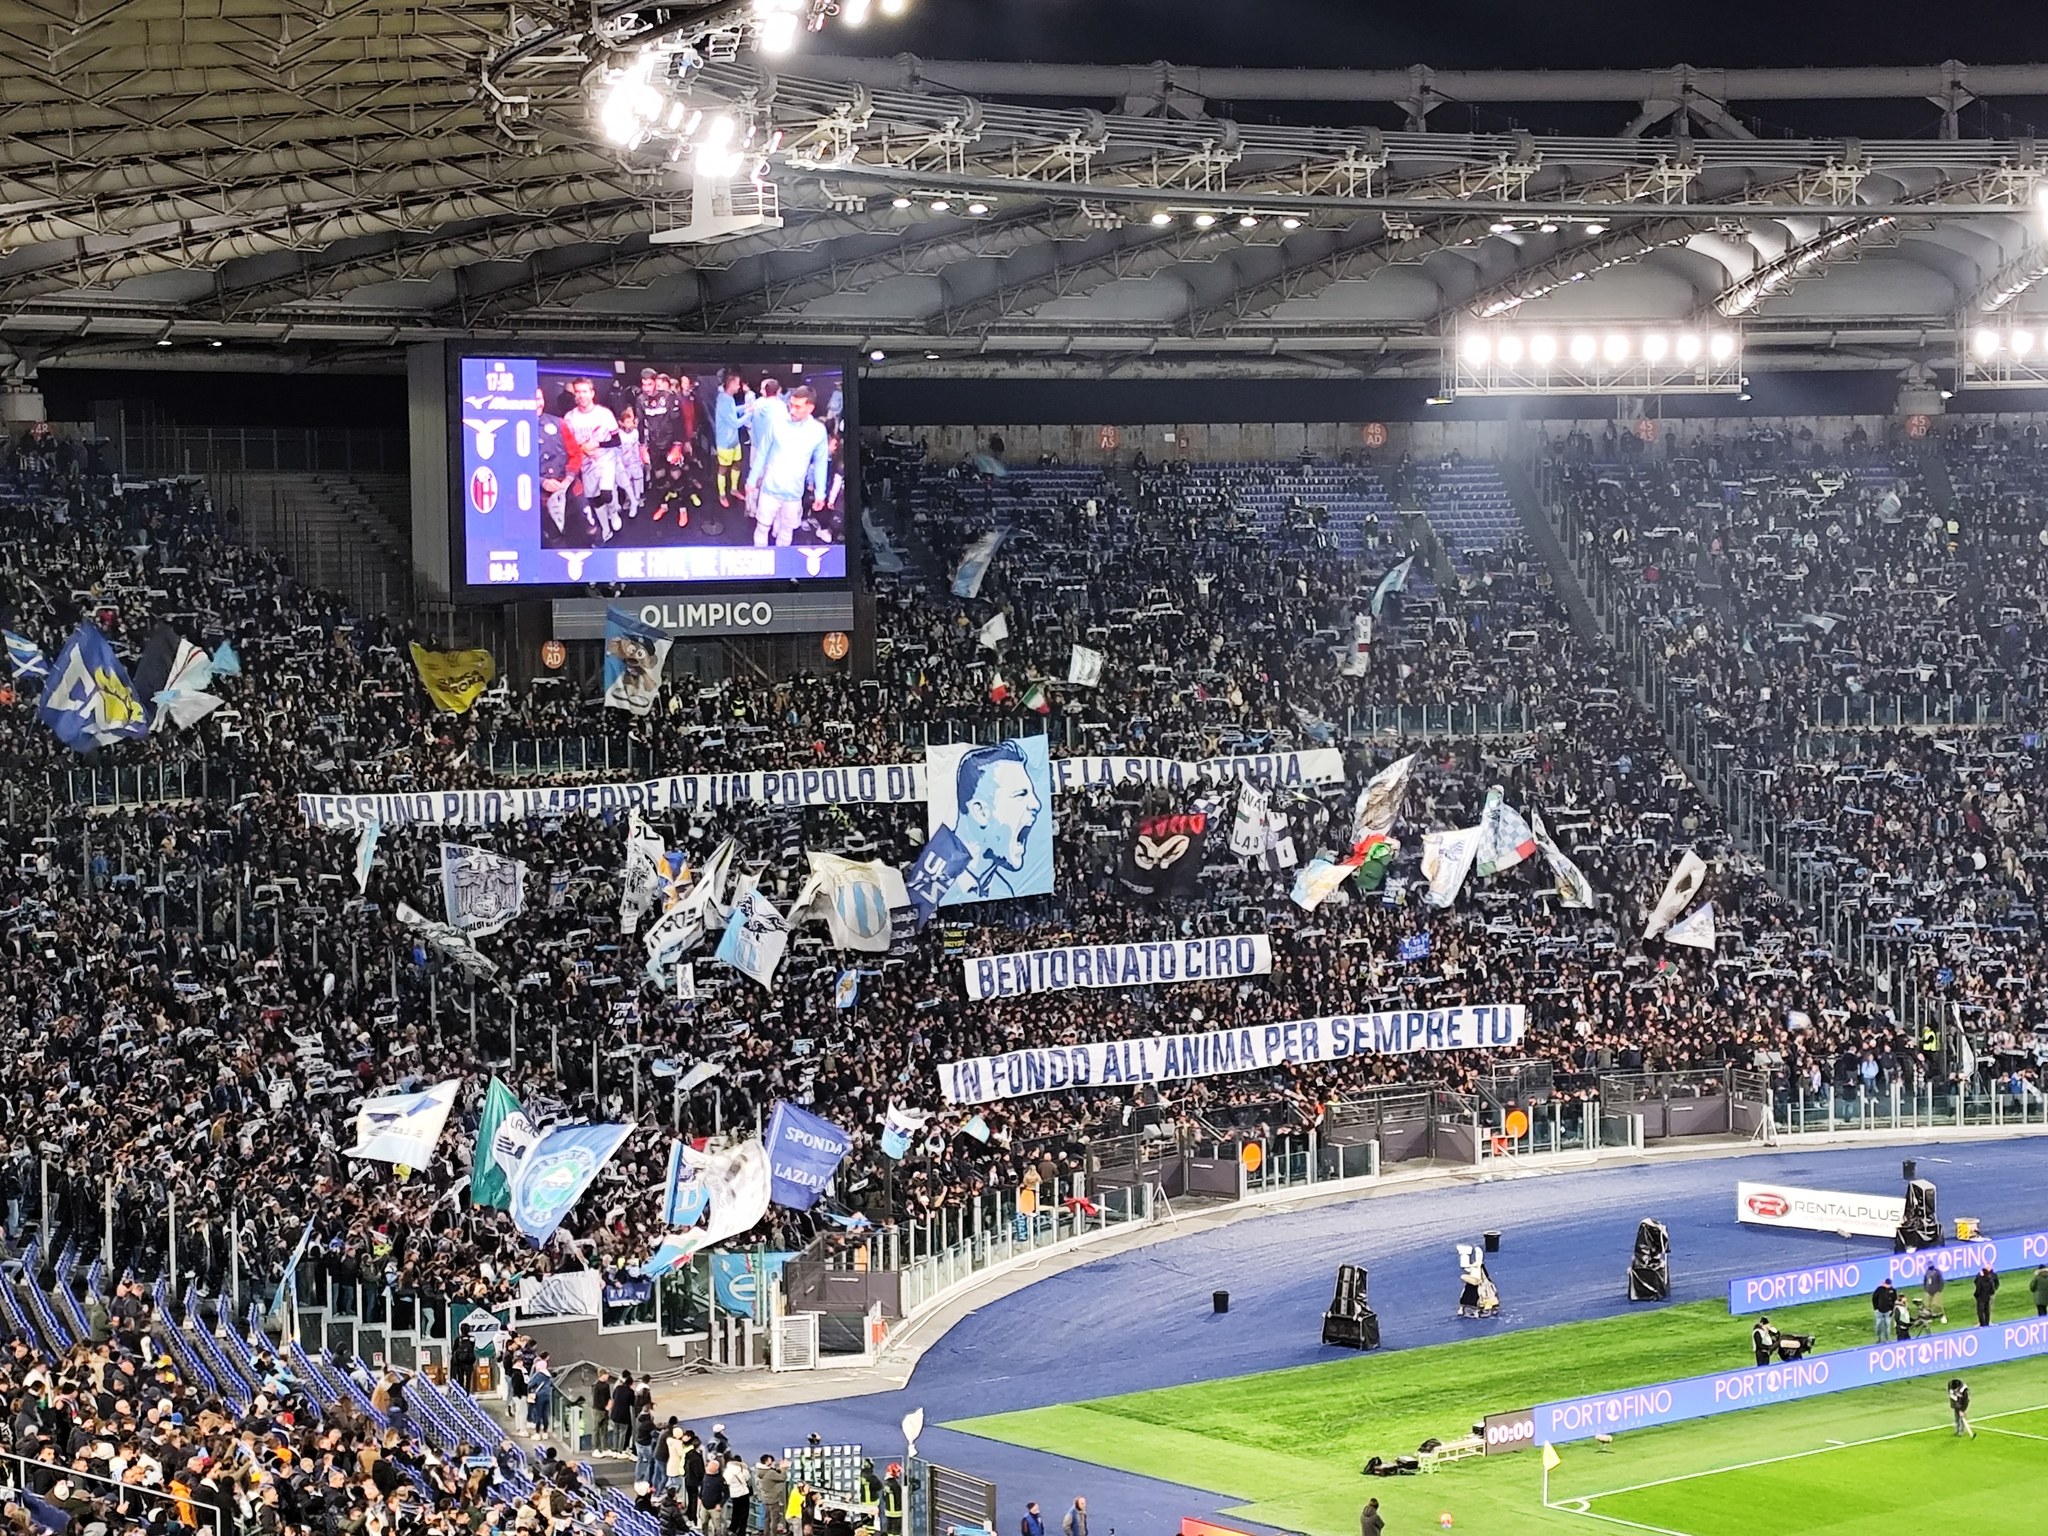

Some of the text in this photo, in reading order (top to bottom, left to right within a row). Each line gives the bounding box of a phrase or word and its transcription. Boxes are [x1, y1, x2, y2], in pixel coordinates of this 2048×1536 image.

[1101, 426, 1114, 436] 46
[1640, 420, 1653, 431] 45
[1910, 426, 1927, 437] AD
[1911, 415, 1926, 426] 45
[516, 420, 530, 457] 0
[1366, 434, 1382, 445] AD
[517, 474, 531, 511] 0
[640, 601, 773, 628] OLIMPICO
[545, 652, 561, 665] AD
[828, 643, 843, 657] AS
[300, 794, 434, 830] NESSUNO
[670, 777, 698, 806] AD
[710, 774, 750, 809] UN
[763, 767, 877, 806] POPOLO
[887, 766, 916, 801] DI
[1082, 759, 1115, 791] LA
[1126, 758, 1185, 793] SUA
[977, 937, 1255, 999] BENTORNATO CIRO
[953, 1061, 982, 1102] IN
[989, 1046, 1091, 1098] FONDO
[1102, 1029, 1258, 1084] ALL'ANIMA
[1264, 1021, 1319, 1066] PER
[1331, 1008, 1463, 1057] SEMPRE
[785, 1126, 843, 1155] SPONDA
[1794, 1200, 1901, 1223] RENTALPLUS
[1747, 1264, 1860, 1304] PORTOFINO
[1889, 1243, 1998, 1280] PORTOFINO
[1551, 1389, 1673, 1433] PORTOFINO
[1715, 1361, 1829, 1403] PORTOFINO
[1868, 1334, 1979, 1374] PORTOFINO
[1487, 1420, 1535, 1445] 00:00
